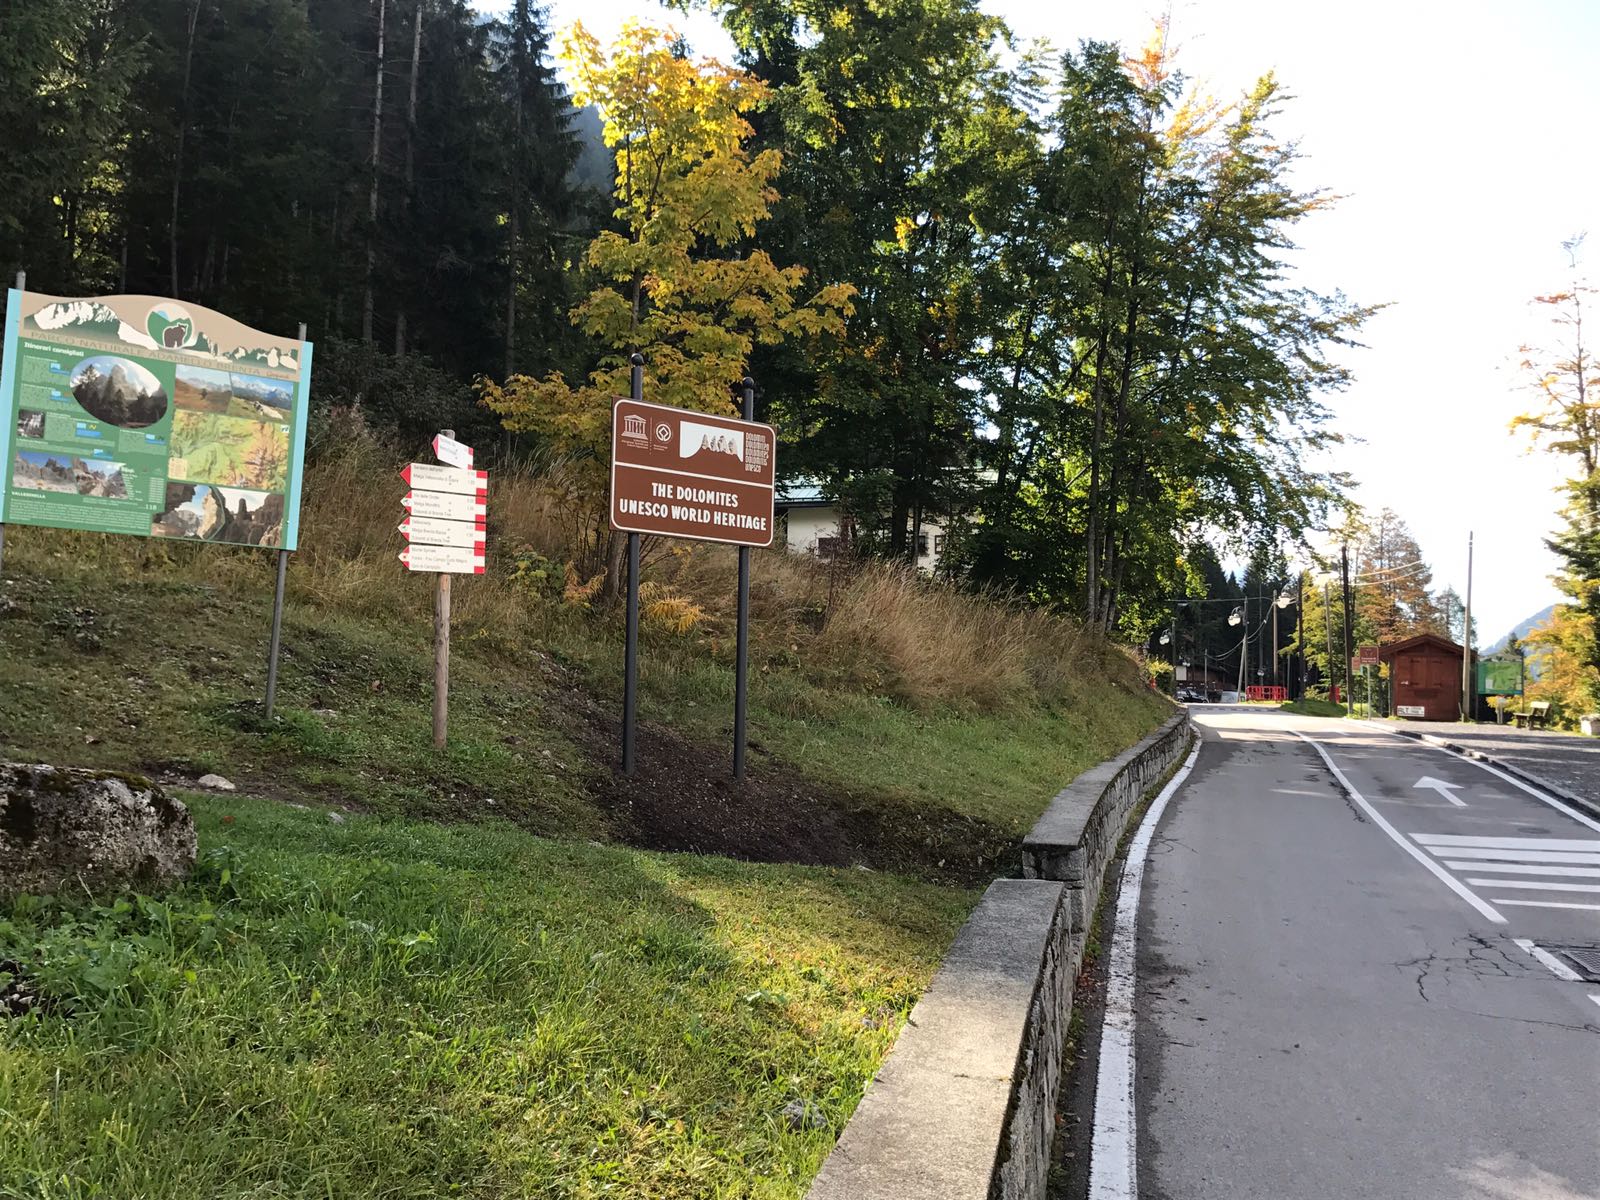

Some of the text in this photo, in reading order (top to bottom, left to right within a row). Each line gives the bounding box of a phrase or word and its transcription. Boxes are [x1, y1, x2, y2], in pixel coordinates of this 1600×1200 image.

[31, 331, 76, 345] PARCO
[80, 337, 141, 355] NATURALE
[150, 350, 213, 366] ADAMELLO
[217, 361, 261, 375] BRENTA
[651, 482, 739, 508] THE DOLOMITES
[619, 498, 767, 531] UNESCO WORLD HERITAGE
